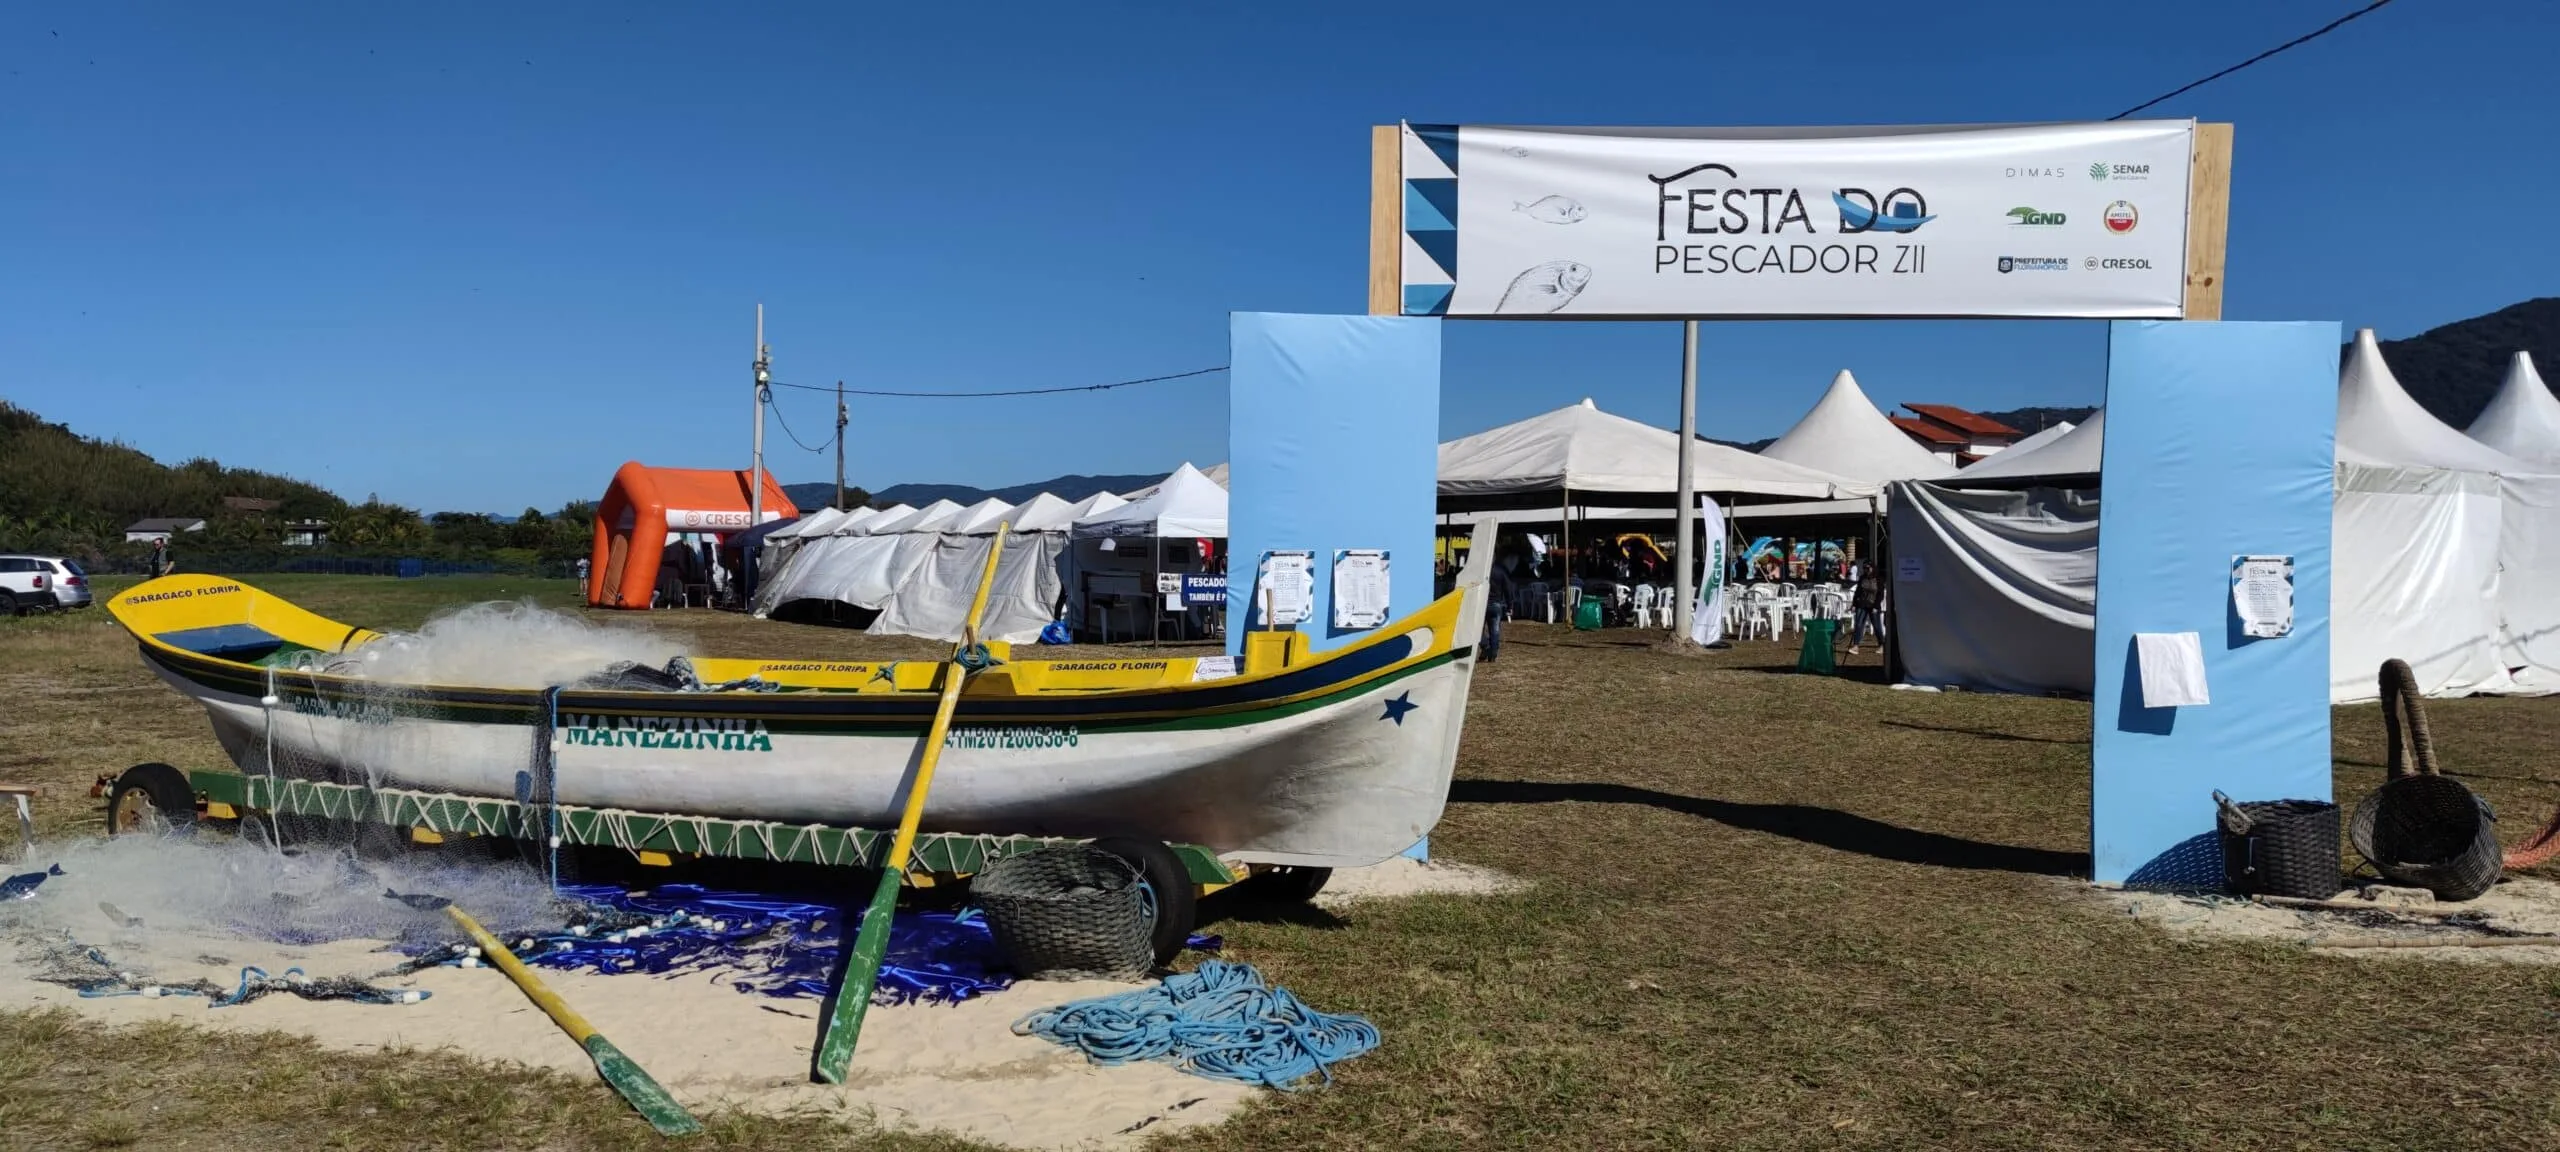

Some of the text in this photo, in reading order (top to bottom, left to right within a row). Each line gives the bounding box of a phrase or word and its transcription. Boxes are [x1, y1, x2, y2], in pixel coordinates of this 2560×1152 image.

[2005, 167, 2065, 178] DIMAS
[2112, 164, 2150, 174] SENAR
[1648, 163, 1927, 241] FESTA DO
[1656, 245, 1925, 274] PESCADOR ZII
[2014, 257, 2068, 265] PREFEITURA DE
[2101, 258, 2152, 270] CRESOL
[705, 513, 751, 525] CRESO
[1188, 577, 1227, 587] PESCADO
[197, 585, 241, 596] FLORIPA
[1189, 591, 1215, 601] TAMBÉM
[825, 664, 867, 673] FLORIPA
[1121, 662, 1167, 671] FLORIPA
[565, 713, 773, 752] MANEZINHA
